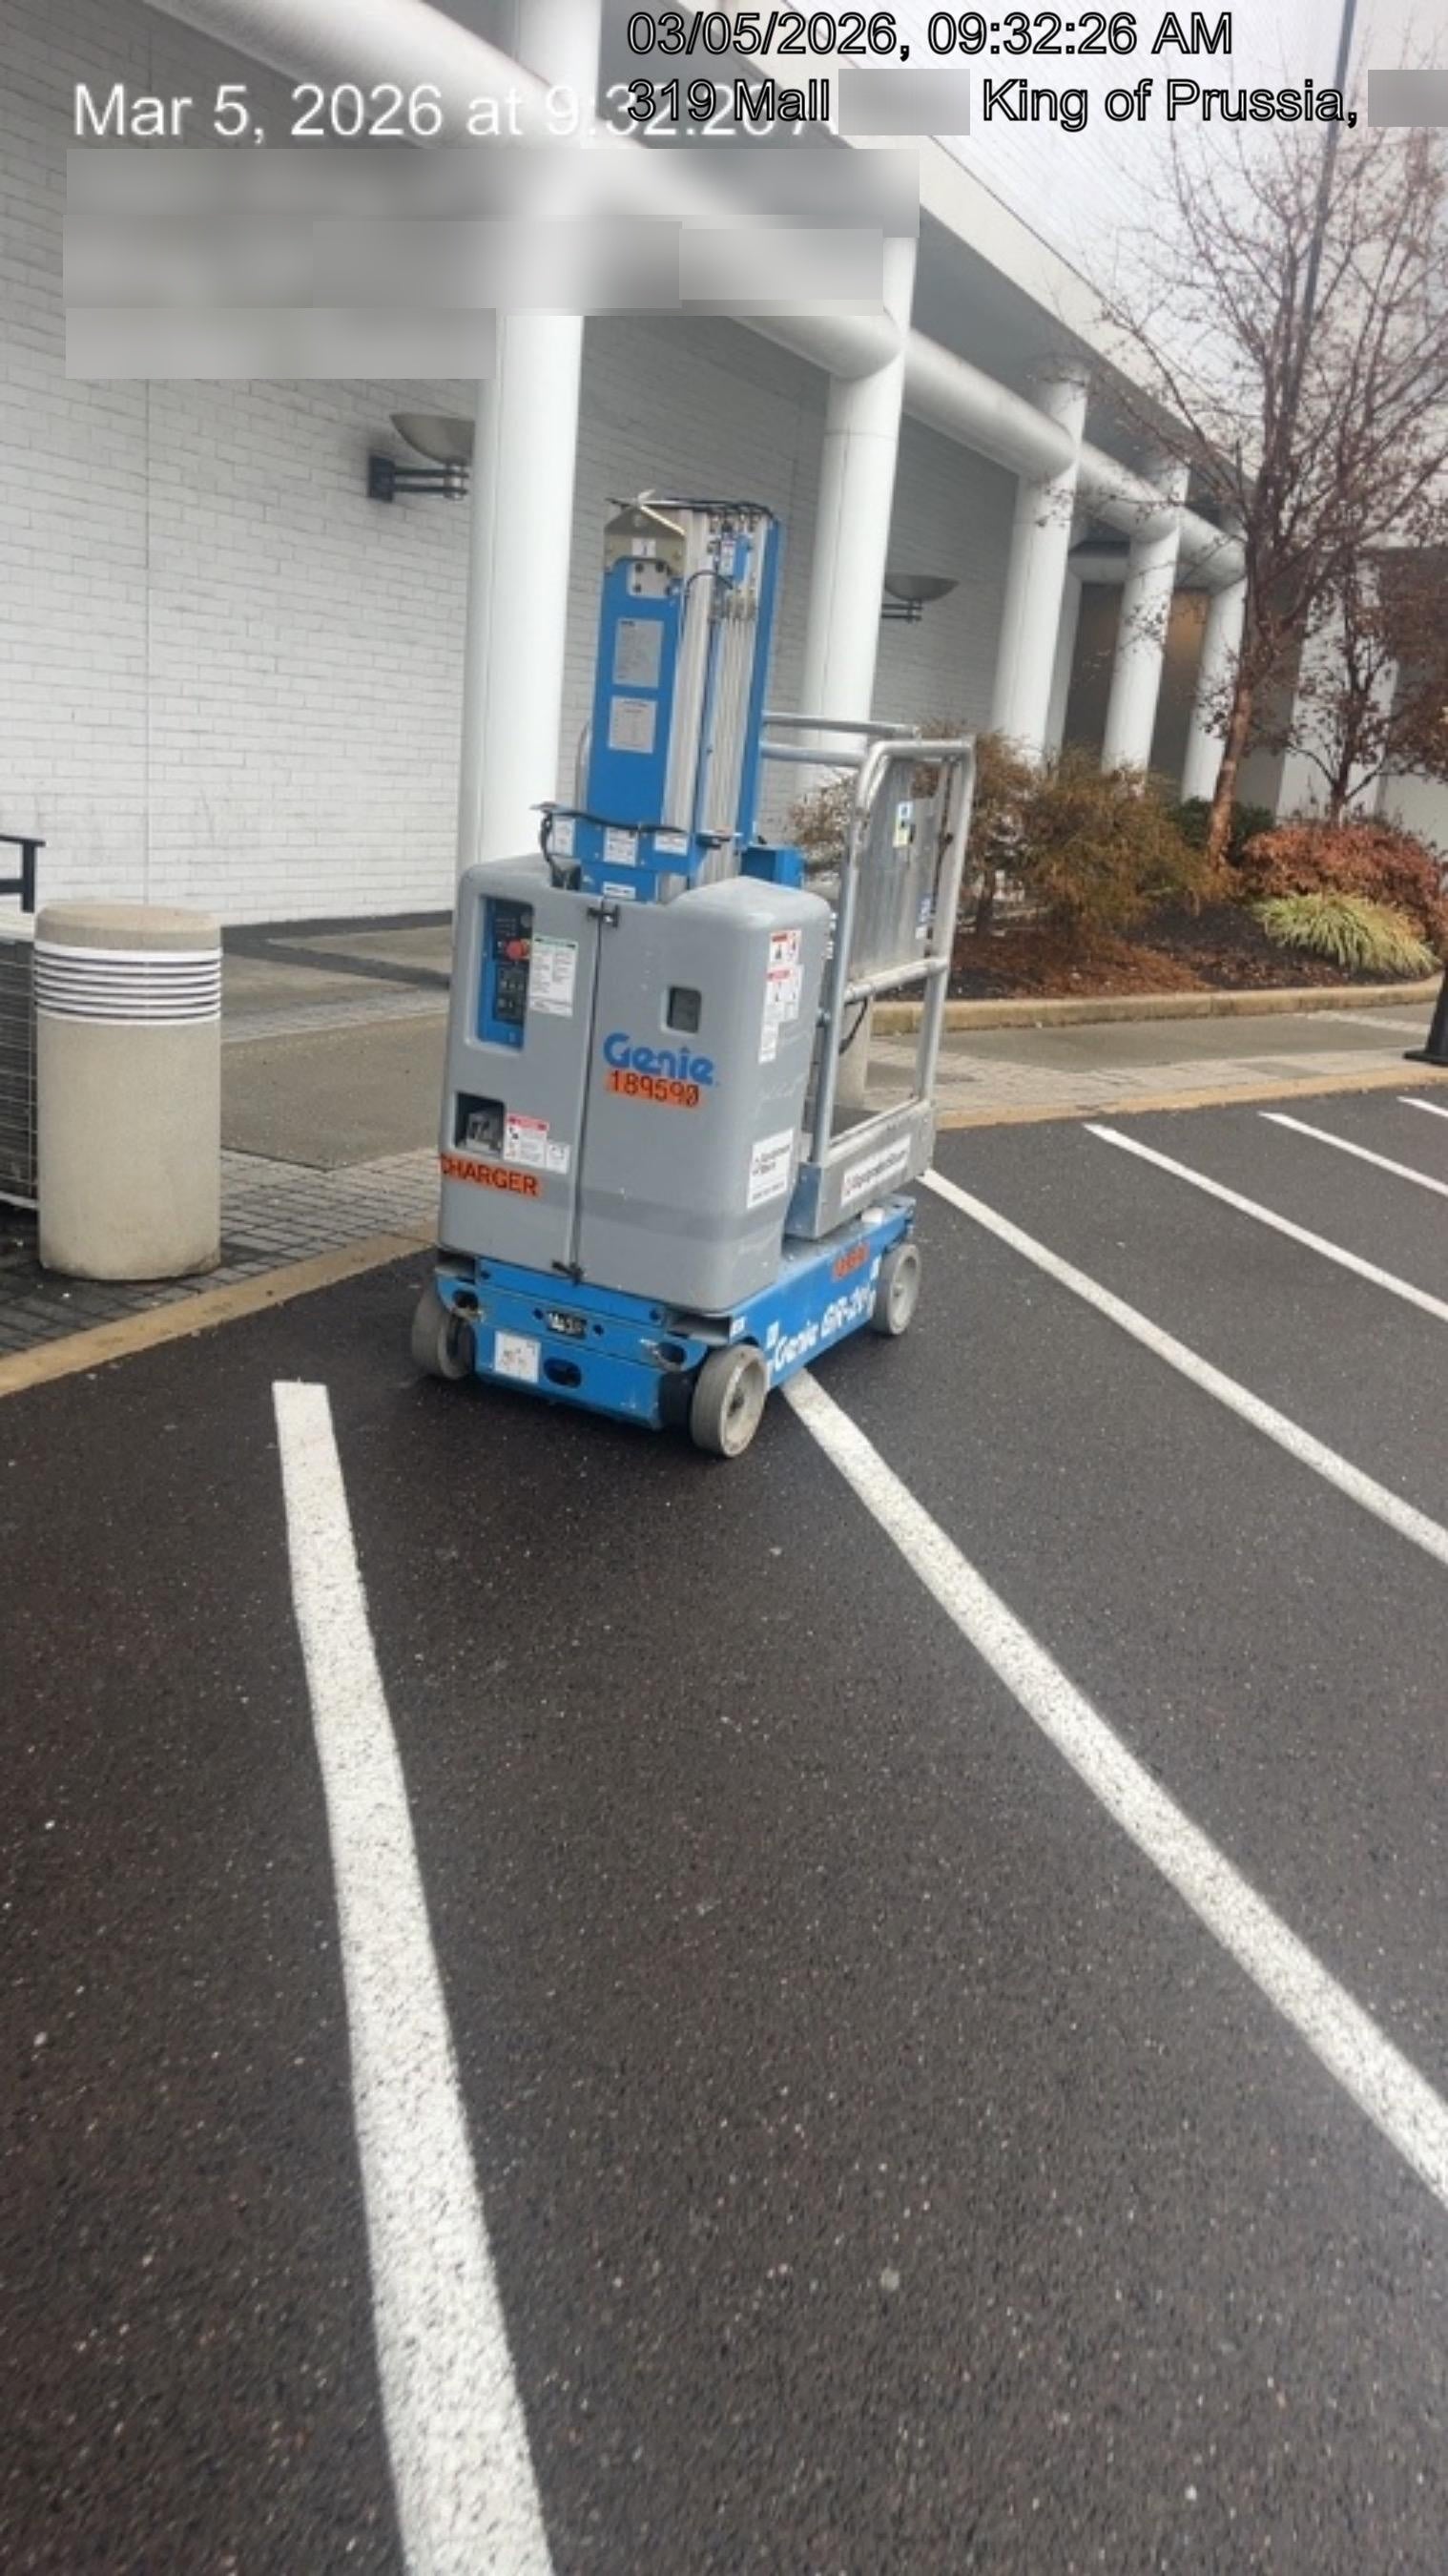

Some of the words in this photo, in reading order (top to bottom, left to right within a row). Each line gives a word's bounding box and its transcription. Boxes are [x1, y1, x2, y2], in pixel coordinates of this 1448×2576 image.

[603, 1032, 714, 1086] Genie
[610, 1070, 700, 1107] 189590
[441, 1153, 536, 1196] CHARGER
